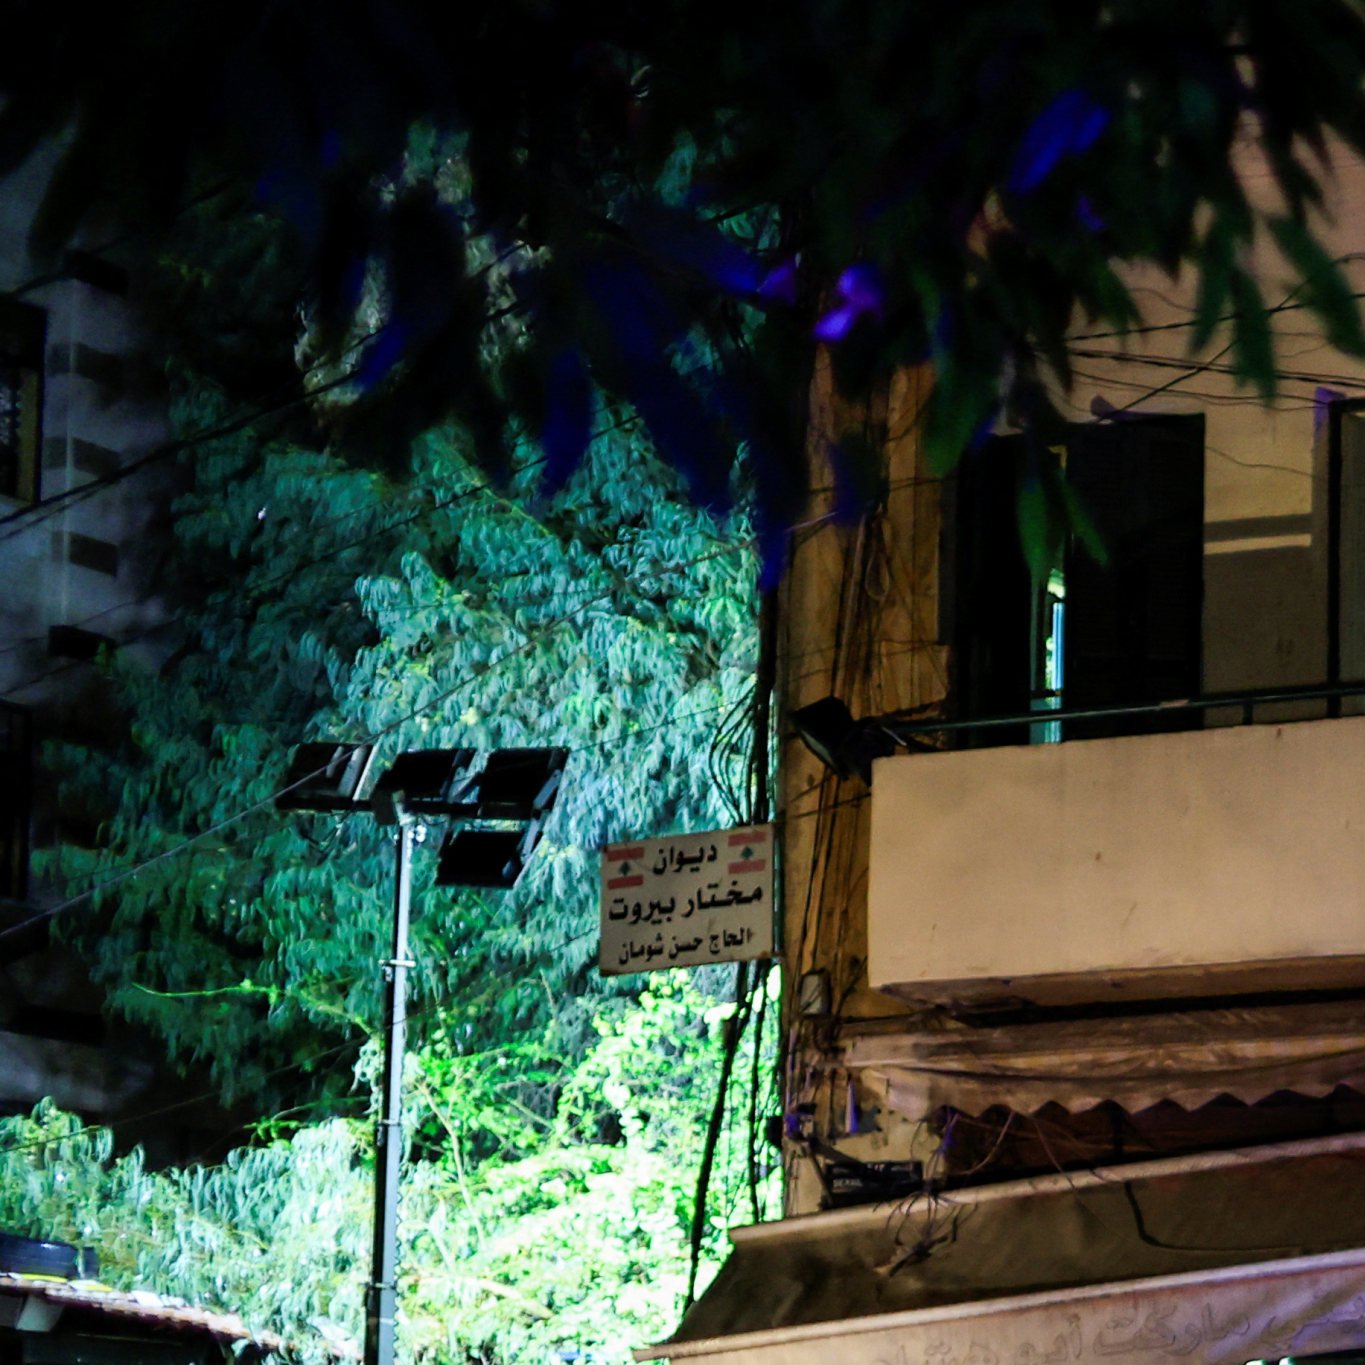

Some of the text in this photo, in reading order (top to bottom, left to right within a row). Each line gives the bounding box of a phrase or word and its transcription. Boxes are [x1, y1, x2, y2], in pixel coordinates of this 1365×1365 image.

[653, 844, 718, 875] ديوان
[609, 880, 763, 924] مختار بيروت
[619, 927, 752, 965] الحاج حسن شومان
[1093, 1298, 1250, 1358] ماركت
